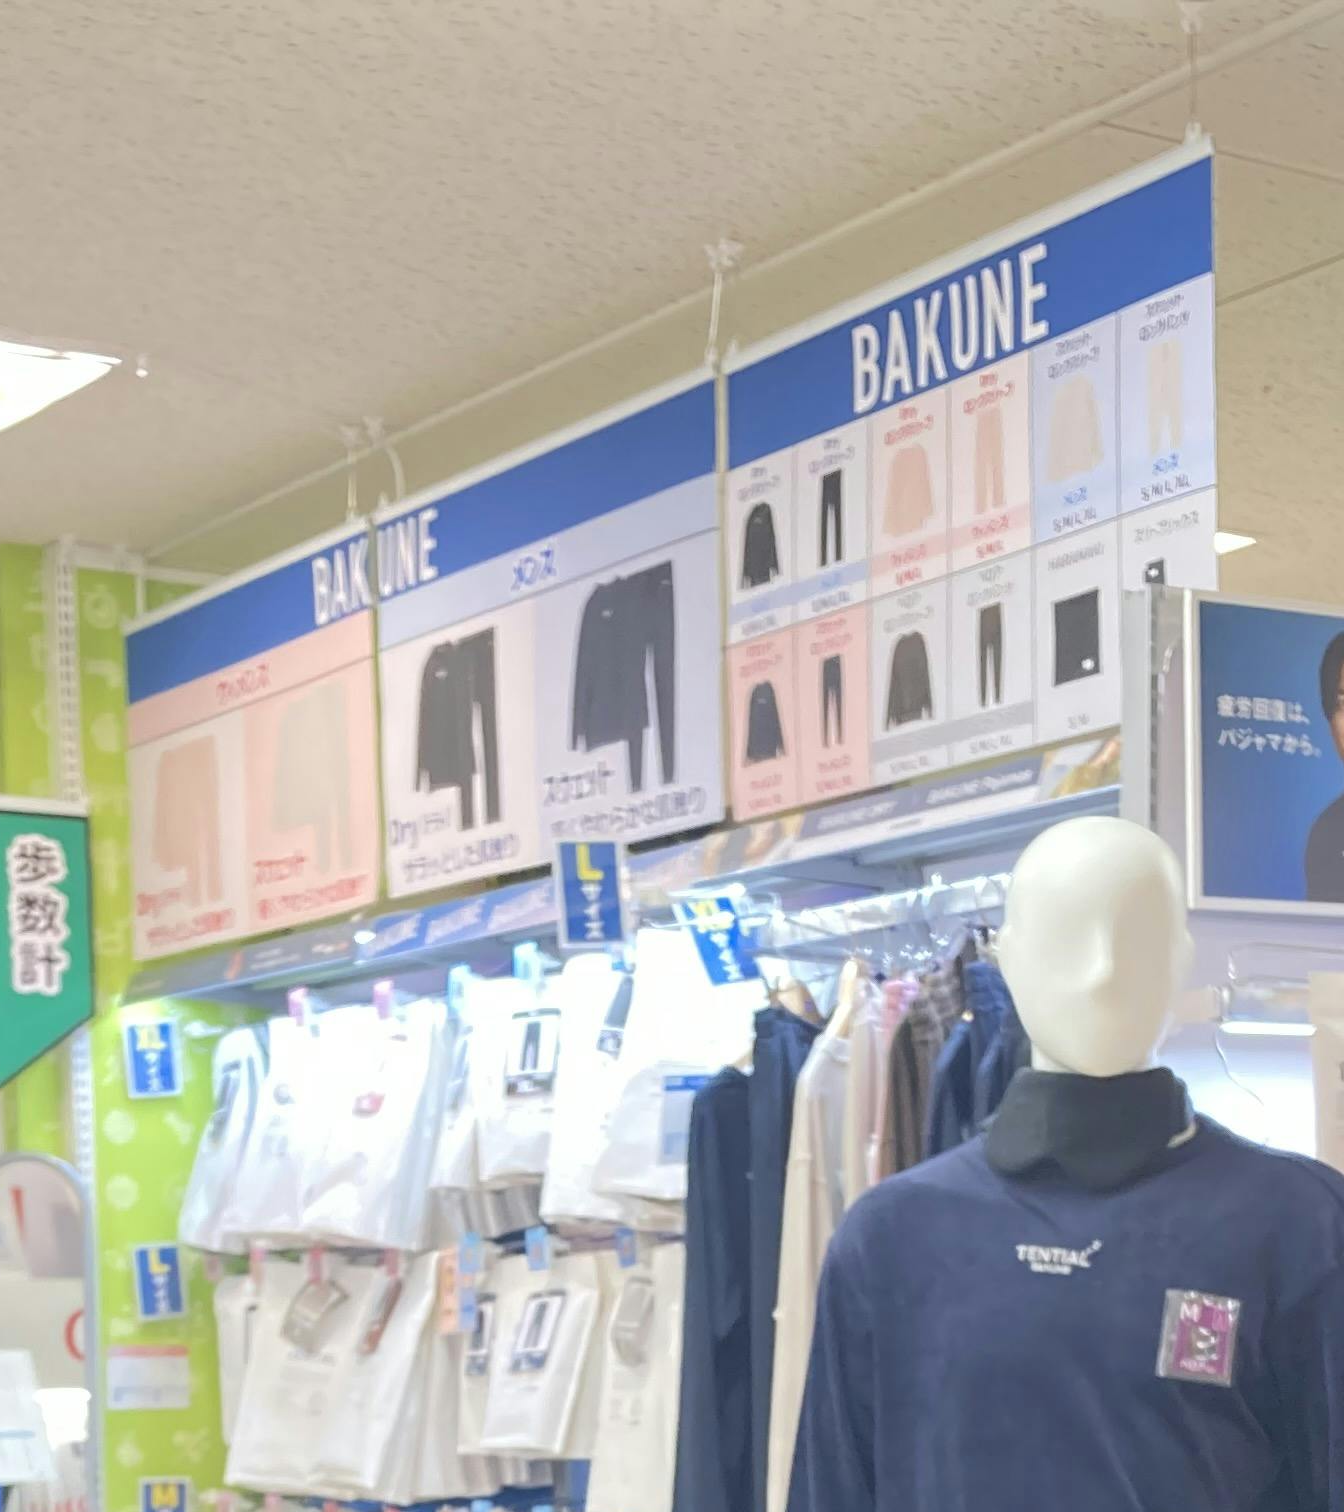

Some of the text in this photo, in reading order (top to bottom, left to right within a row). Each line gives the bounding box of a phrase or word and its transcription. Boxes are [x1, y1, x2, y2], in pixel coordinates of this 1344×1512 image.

[851, 241, 1050, 414] BAKUNE
[311, 508, 441, 627] BAKUNE
[1216, 693, 1311, 725] 疲労回復は、
[1217, 726, 1323, 759] パジャマから。
[13, 839, 65, 992] 歩数計
[1015, 1243, 1091, 1269] TENTIAL
[1180, 1303, 1201, 1323] M
